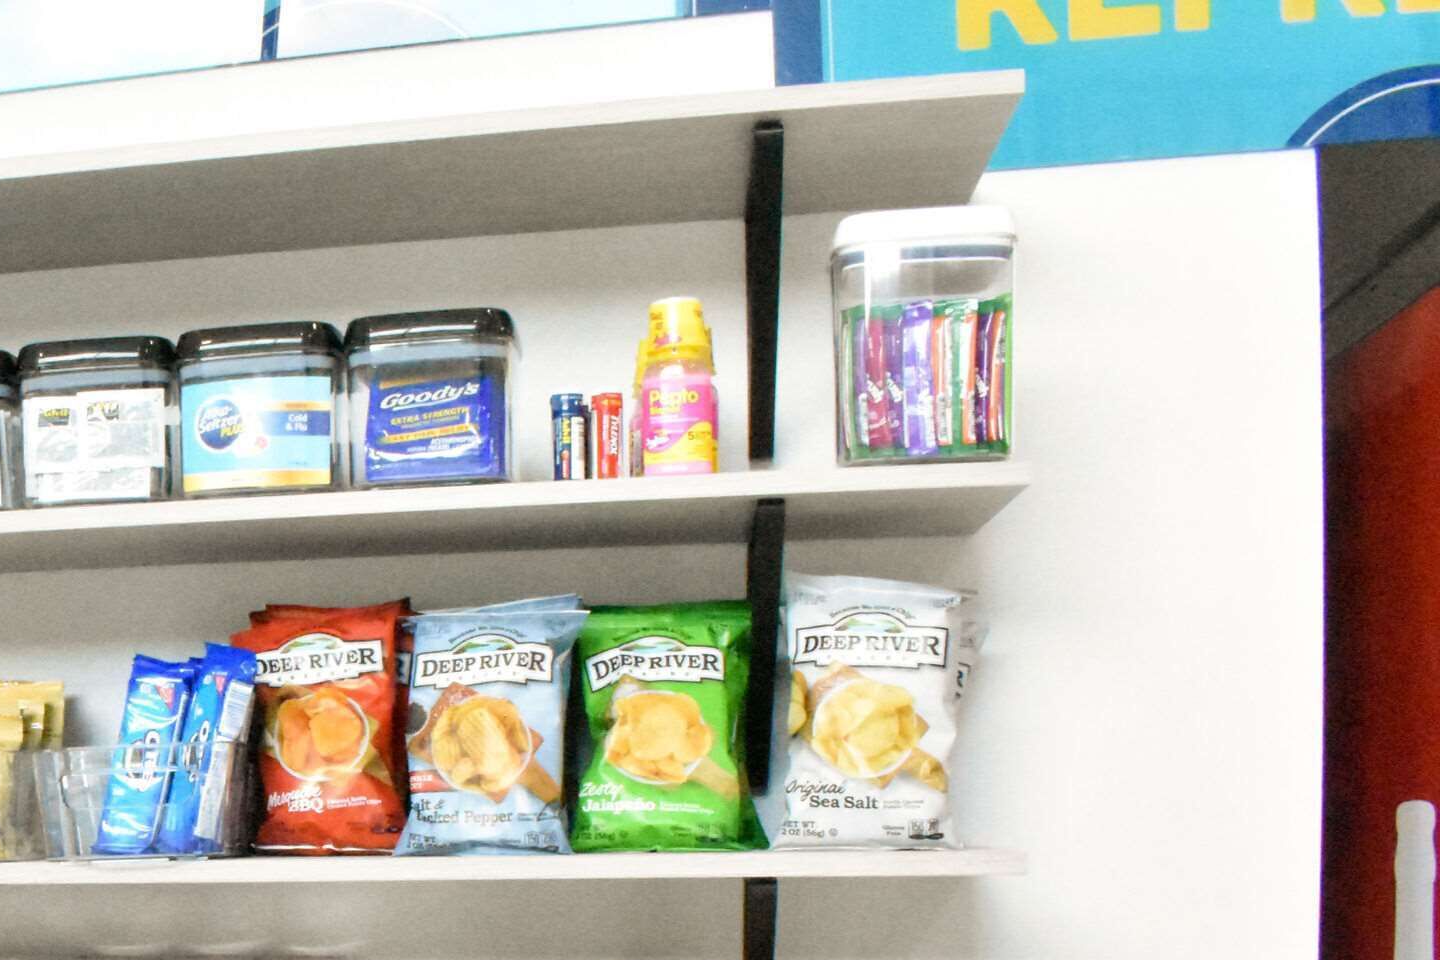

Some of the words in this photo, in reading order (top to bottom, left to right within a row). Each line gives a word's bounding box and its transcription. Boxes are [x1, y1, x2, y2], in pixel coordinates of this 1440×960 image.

[380, 381, 479, 408] Goody's
[803, 635, 861, 654] DEEP
[865, 635, 940, 656] RIVER
[310, 648, 377, 669] RIVER
[421, 656, 476, 677] DEEP
[480, 651, 546, 672] RIVER
[592, 654, 645, 681] DEEP
[648, 653, 720, 672] RIVER
[785, 778, 847, 801] Original
[411, 798, 431, 811] alt
[809, 795, 840, 808] Sea
[844, 795, 879, 809] Salt
[464, 811, 513, 826] Pepper
